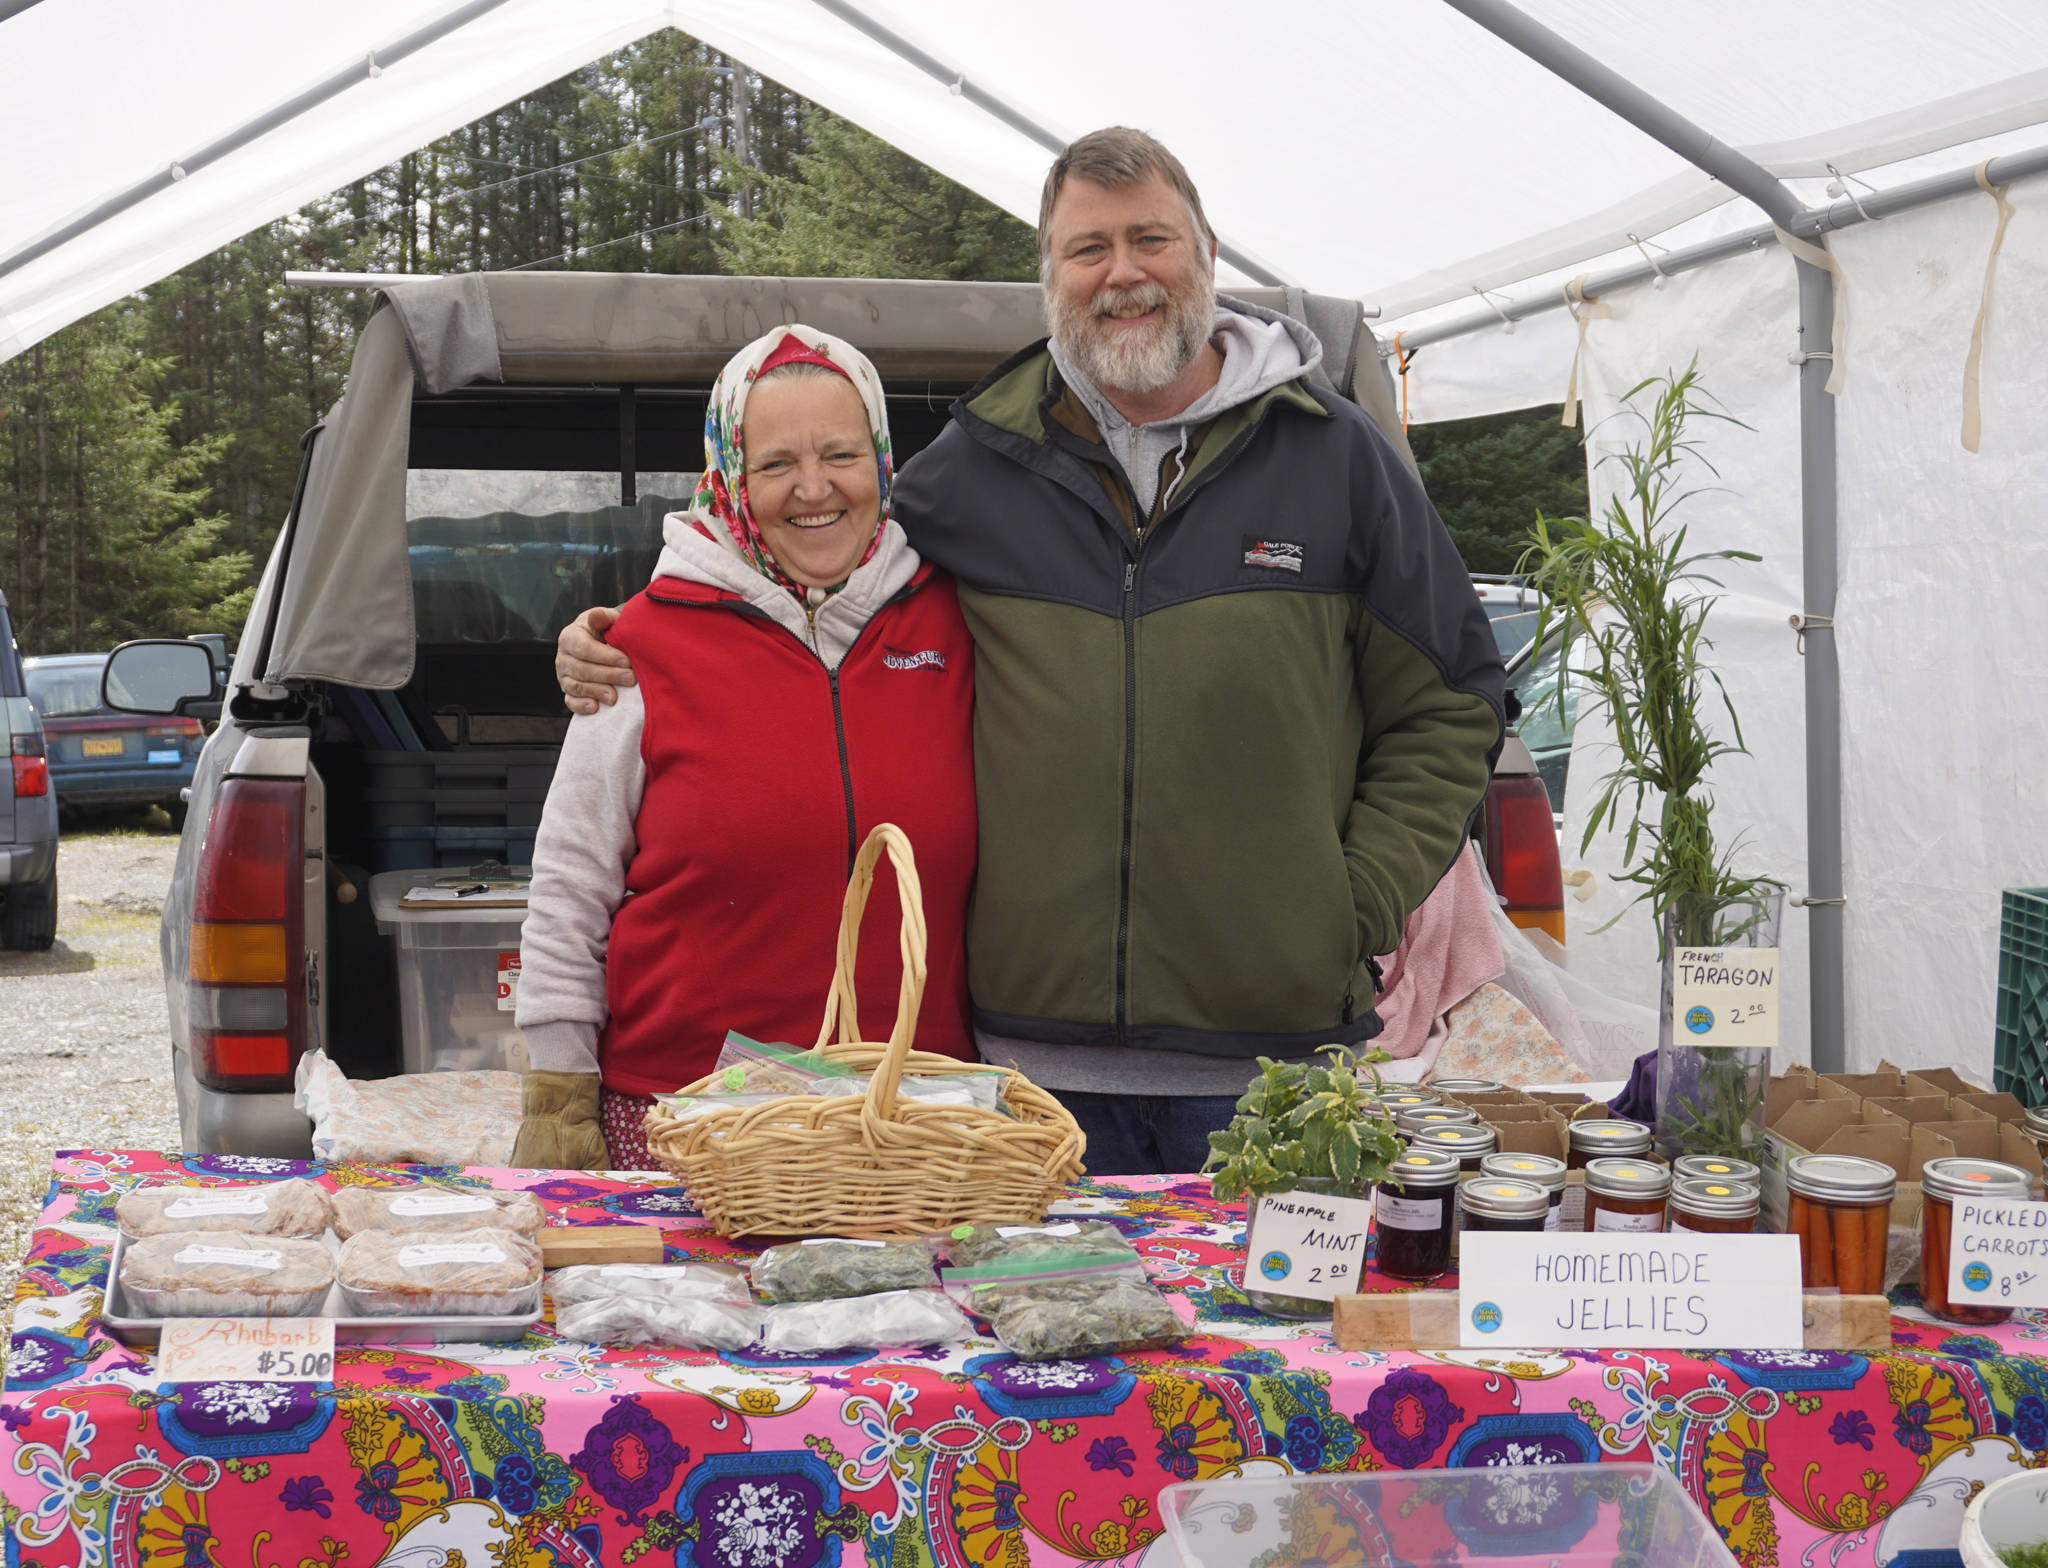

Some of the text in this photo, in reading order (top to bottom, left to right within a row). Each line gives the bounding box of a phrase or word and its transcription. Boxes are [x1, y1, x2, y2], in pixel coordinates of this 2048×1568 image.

[1681, 950, 1724, 962] FRENCH
[1679, 964, 1773, 988] TARAGON
[1264, 1198, 1335, 1222] PINEAPPLE
[1962, 1205, 2047, 1228] PICKLED
[1301, 1228, 1362, 1251] MINT
[1963, 1234, 2048, 1257] CARROTS
[1535, 1250, 1710, 1284] HOMEMADE
[1556, 1295, 1708, 1336] JELLIES
[169, 1318, 321, 1347] Rhubarb
[256, 1350, 332, 1377] $5.00
